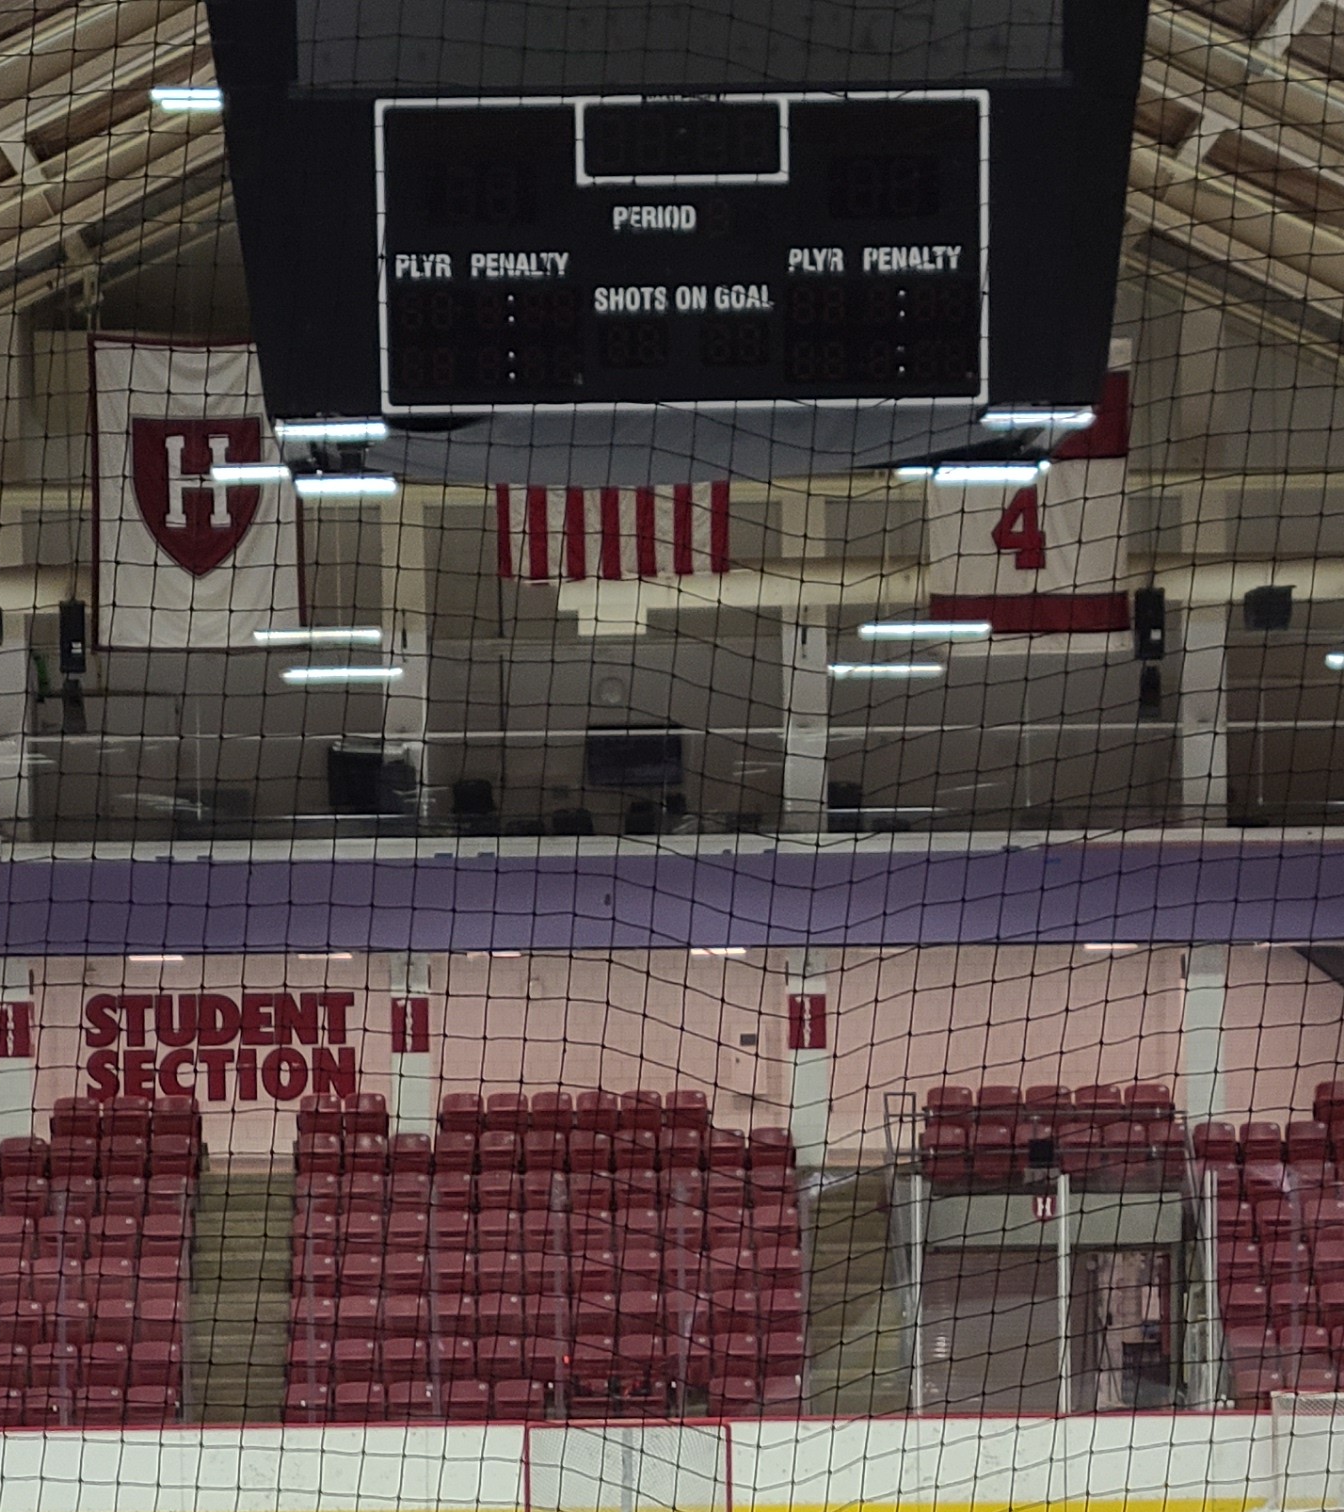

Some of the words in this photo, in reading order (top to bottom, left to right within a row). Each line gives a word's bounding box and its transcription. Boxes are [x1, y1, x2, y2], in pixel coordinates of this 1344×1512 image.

[613, 205, 696, 230] PERIOD
[395, 254, 452, 278] PLYR
[471, 252, 569, 276] PENALTY
[789, 248, 844, 272] PLYR
[863, 246, 961, 271] PENALTY
[594, 287, 667, 311] SHOTS
[675, 286, 707, 310] ON
[714, 285, 773, 309] GOAL
[164, 434, 232, 528] H
[991, 484, 1047, 570] 4
[85, 992, 354, 1047] STUDENT
[86, 1047, 355, 1100] SECTION
